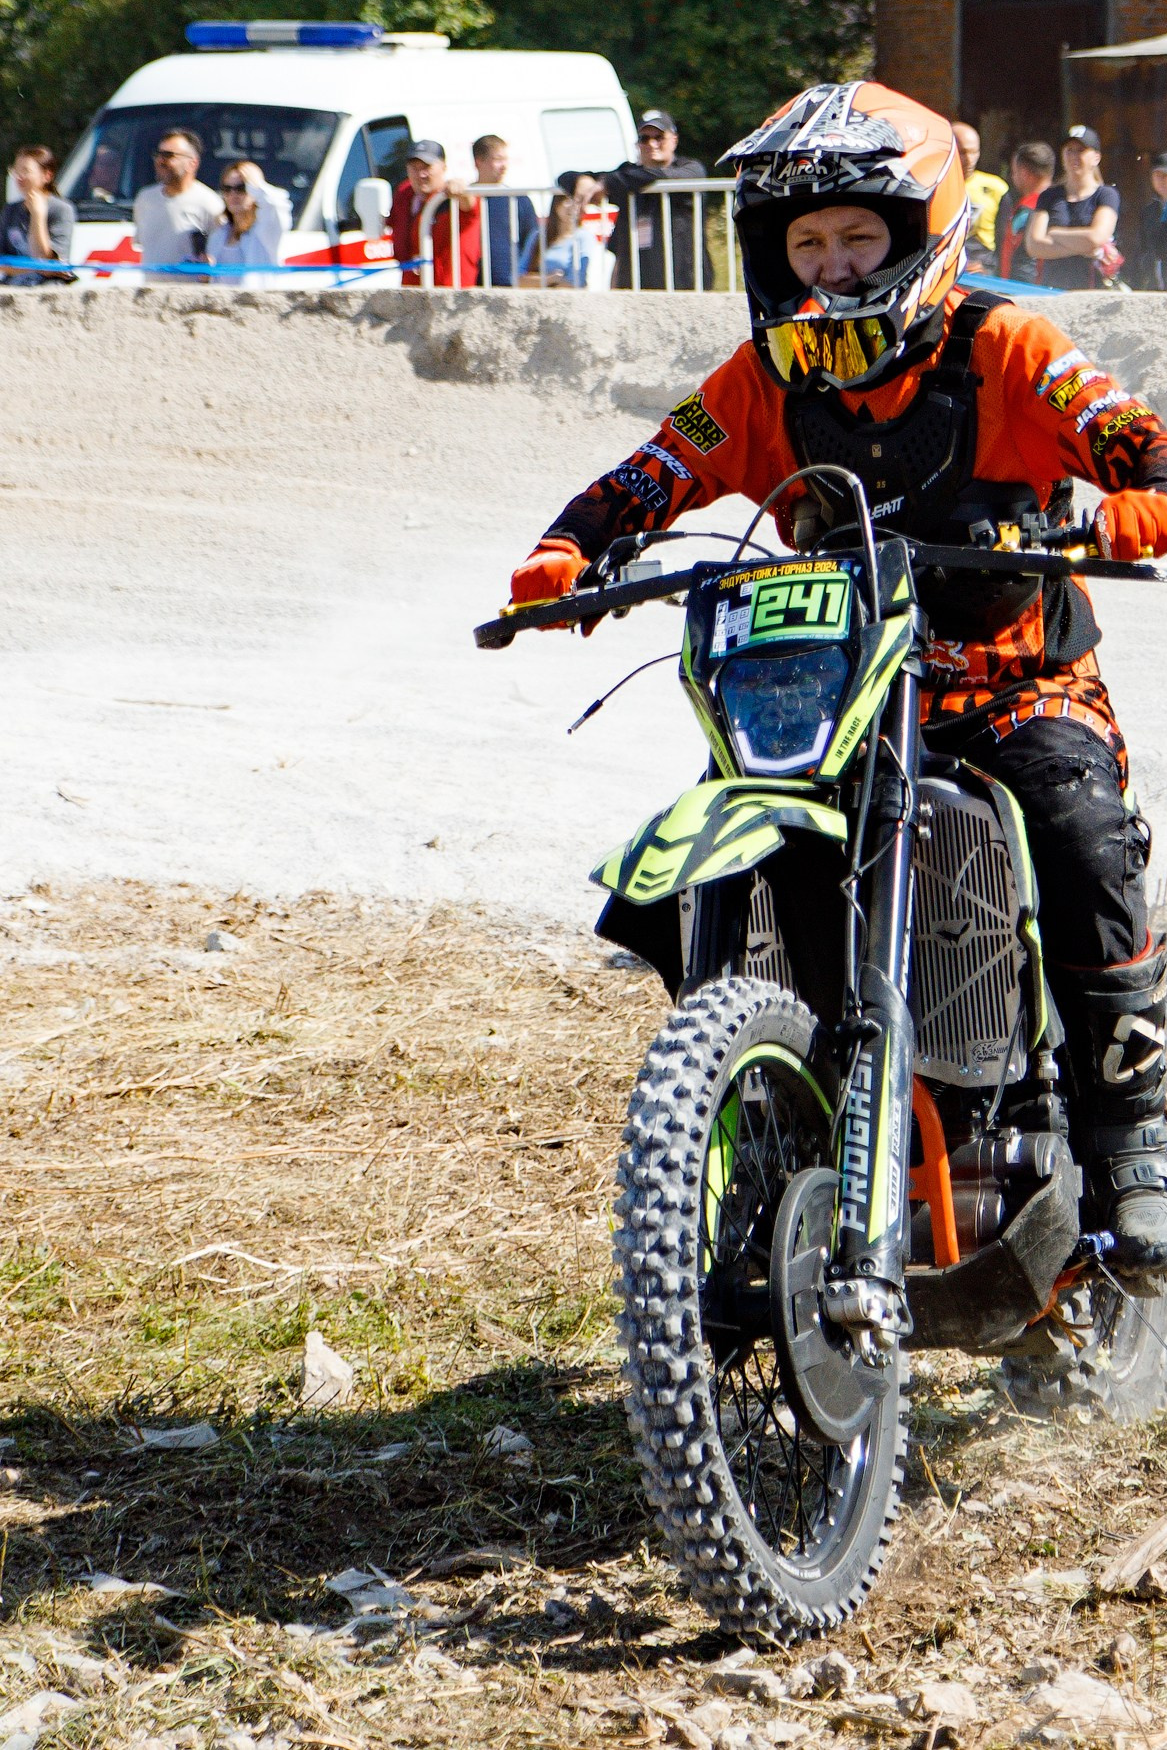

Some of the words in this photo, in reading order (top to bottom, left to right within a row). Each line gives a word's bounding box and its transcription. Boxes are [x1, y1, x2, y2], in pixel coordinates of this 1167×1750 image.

[674, 415, 712, 452] GLIDE
[684, 402, 723, 444] HARD
[1076, 390, 1131, 434] JARVIS
[719, 563, 813, 590] ЭНДУРО-ГОНКА-ГОРНАЗ
[814, 561, 838, 573] 2024
[754, 582, 846, 629] 241
[835, 749, 845, 760] IN
[840, 734, 853, 751] THE
[848, 715, 863, 739] RACE
